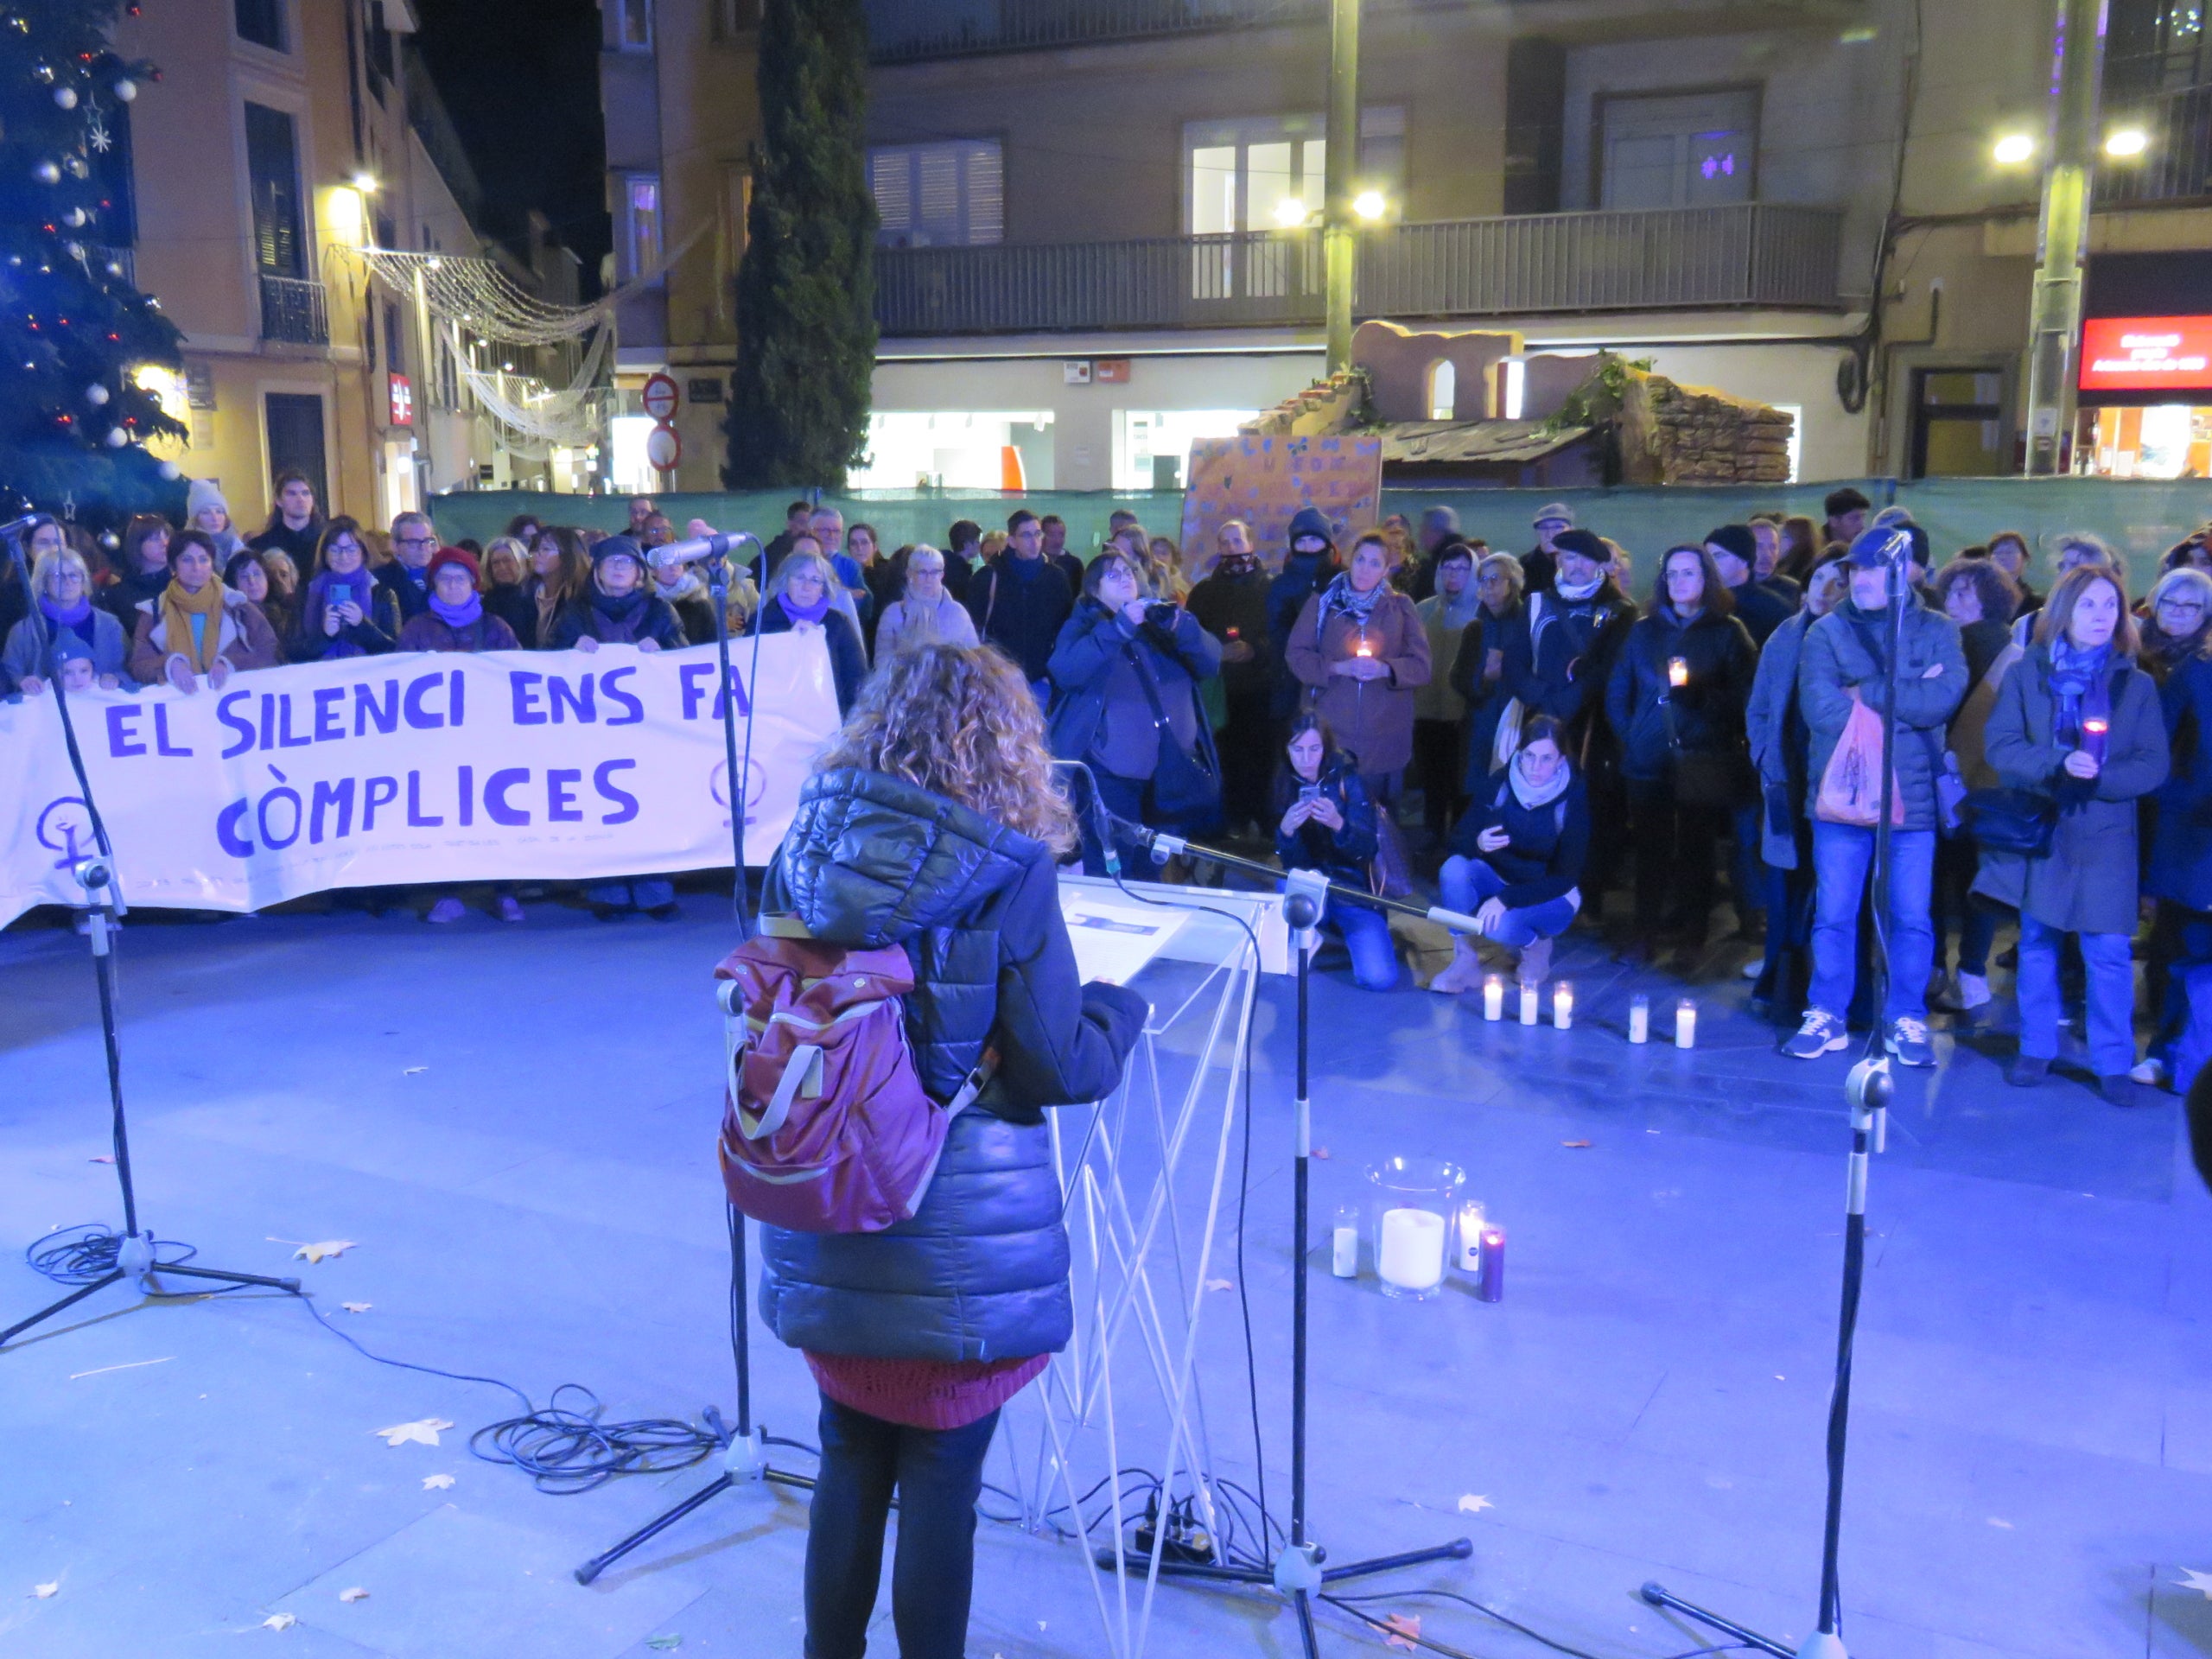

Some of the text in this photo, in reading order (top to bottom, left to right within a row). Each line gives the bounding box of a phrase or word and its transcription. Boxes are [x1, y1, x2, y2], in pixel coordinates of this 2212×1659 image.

[106, 662, 750, 760] EL SILENCI ENS FA
[216, 758, 639, 859] CÒMPLICES
